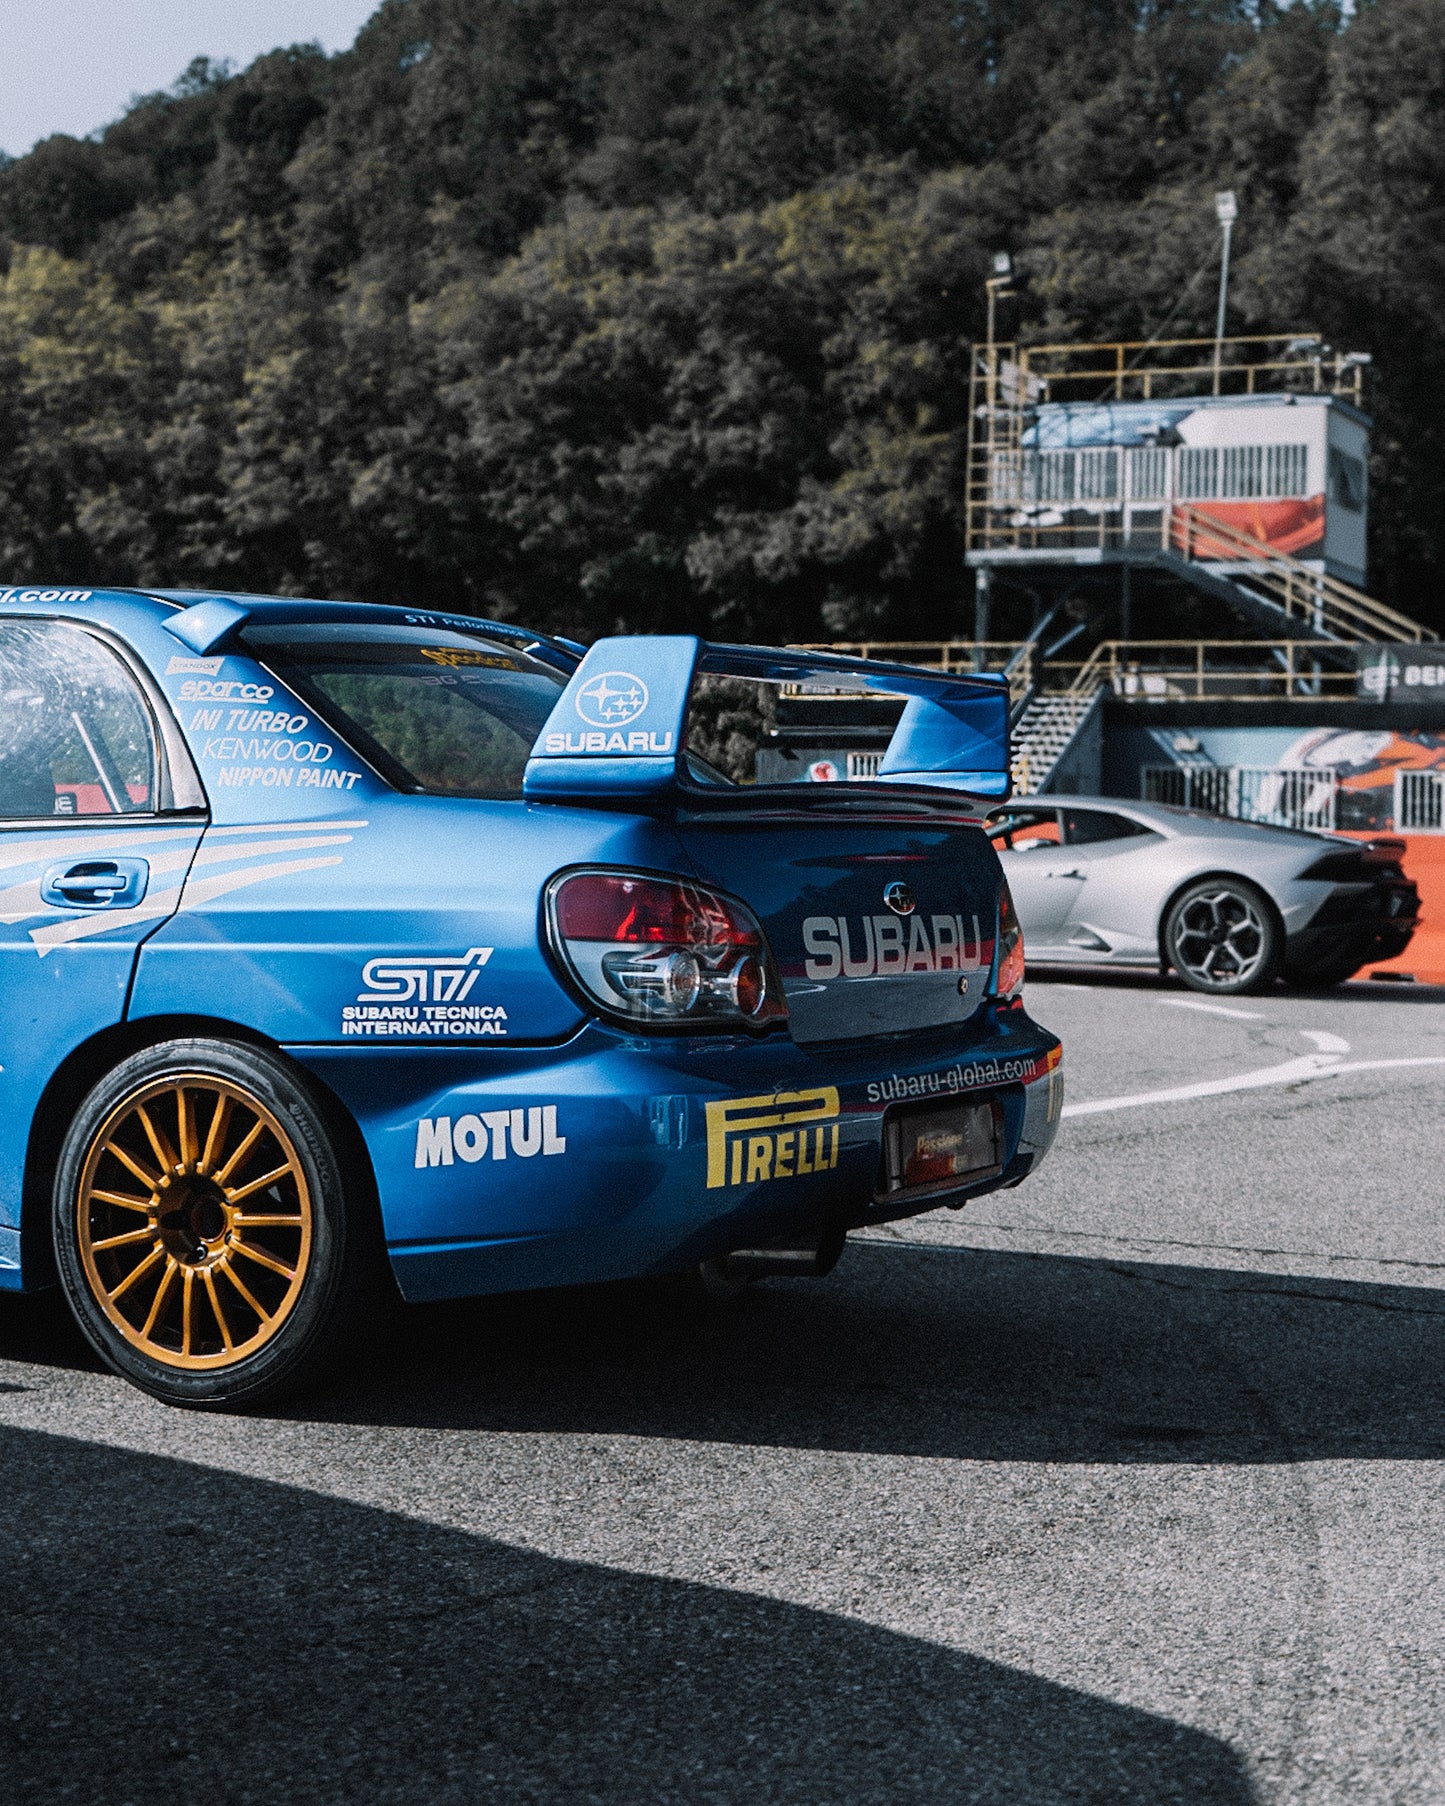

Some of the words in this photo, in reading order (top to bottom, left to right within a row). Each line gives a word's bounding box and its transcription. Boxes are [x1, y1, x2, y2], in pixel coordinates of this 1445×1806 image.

[405, 614, 436, 624] STI
[179, 680, 274, 702] sparco
[225, 710, 309, 734] TURBO
[201, 738, 333, 763] KENWOOD
[544, 731, 673, 753] SUBARU
[218, 766, 294, 788] NIPPON
[296, 768, 362, 790] PAINT
[802, 914, 982, 980] SUBARU
[341, 1006, 419, 1020] SUBARU
[422, 1006, 508, 1020] TECNICA
[341, 1021, 508, 1035] INTERNATIONAL
[867, 1058, 1037, 1103] subaru-global.com
[414, 1104, 566, 1169] MOTUL
[705, 1086, 840, 1189] PIRELLI
